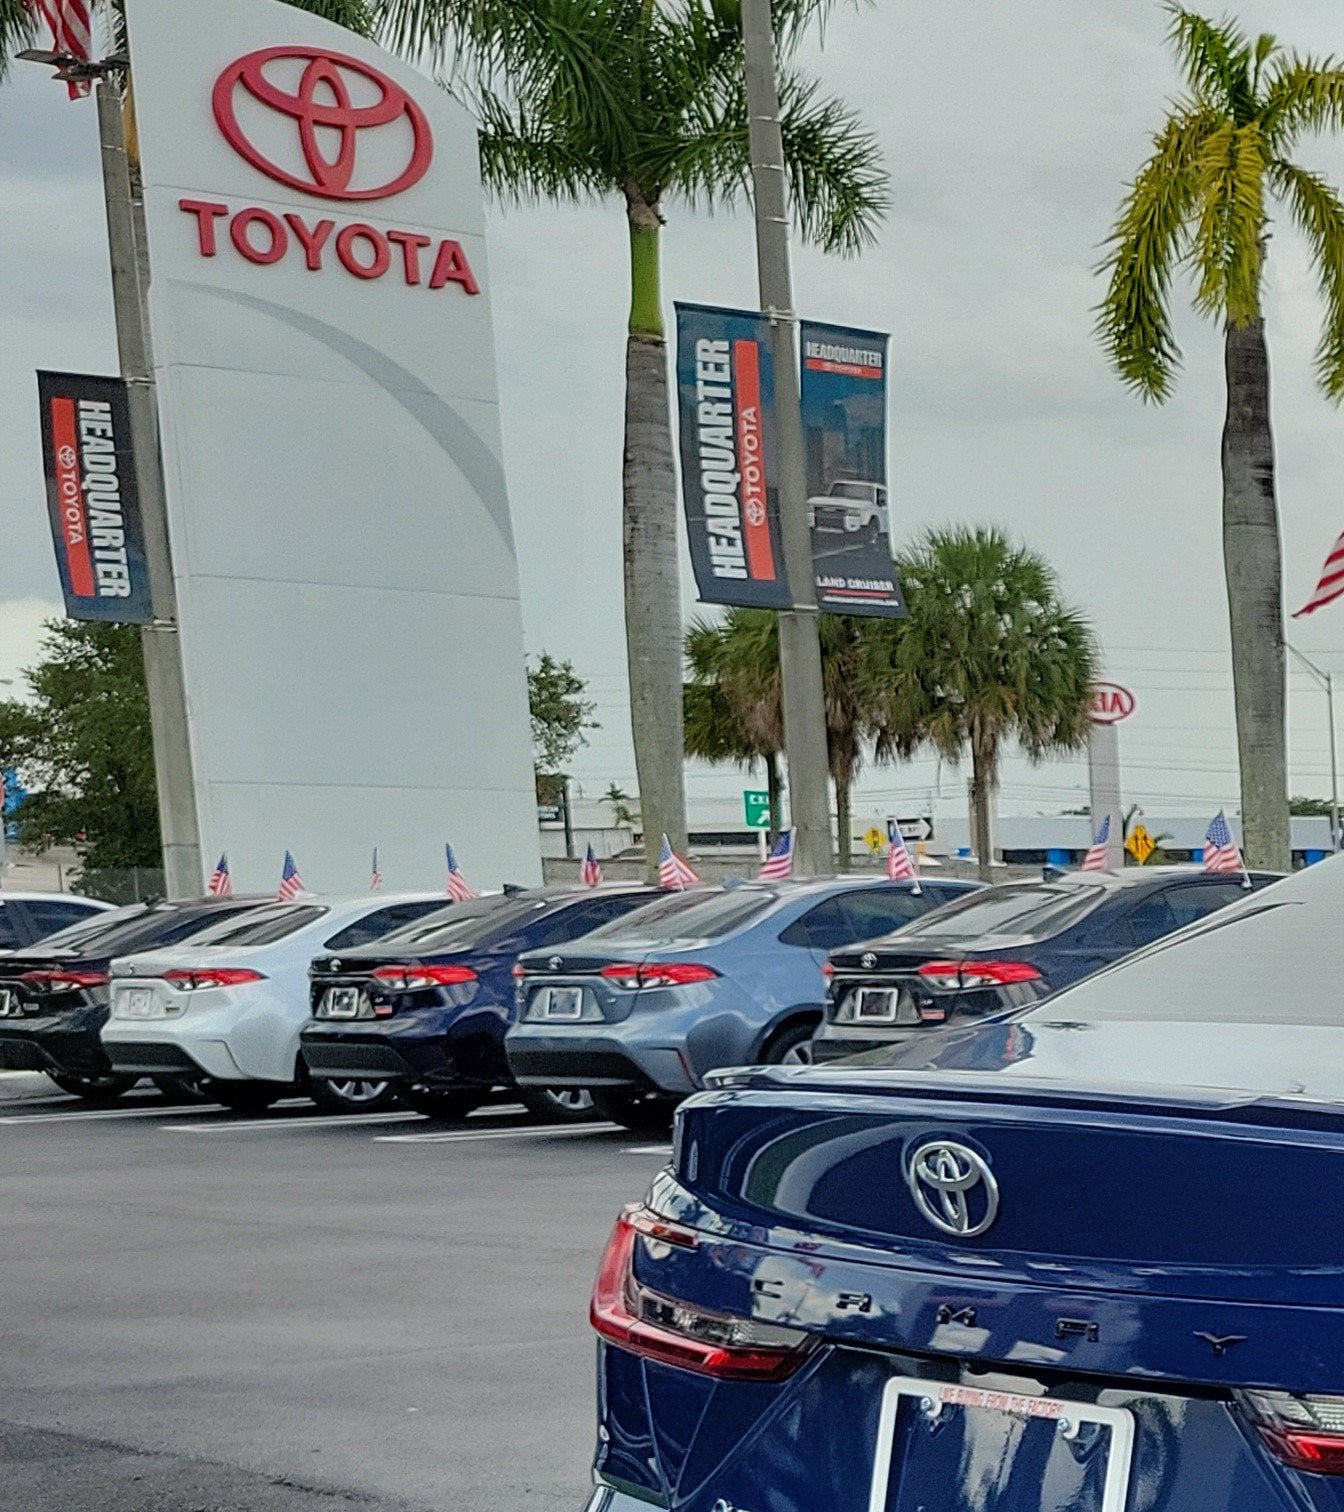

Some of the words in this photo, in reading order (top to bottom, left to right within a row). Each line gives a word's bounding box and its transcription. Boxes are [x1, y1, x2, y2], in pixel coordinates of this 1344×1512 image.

[179, 199, 480, 295] TOYOTA
[696, 338, 748, 579] HEADQUARTER
[741, 406, 761, 495] TOYOTA
[61, 472, 83, 544] TOYOTA
[78, 399, 132, 598] HEADQUARTER
[816, 576, 846, 588] LAND
[847, 578, 894, 591] CRUISER
